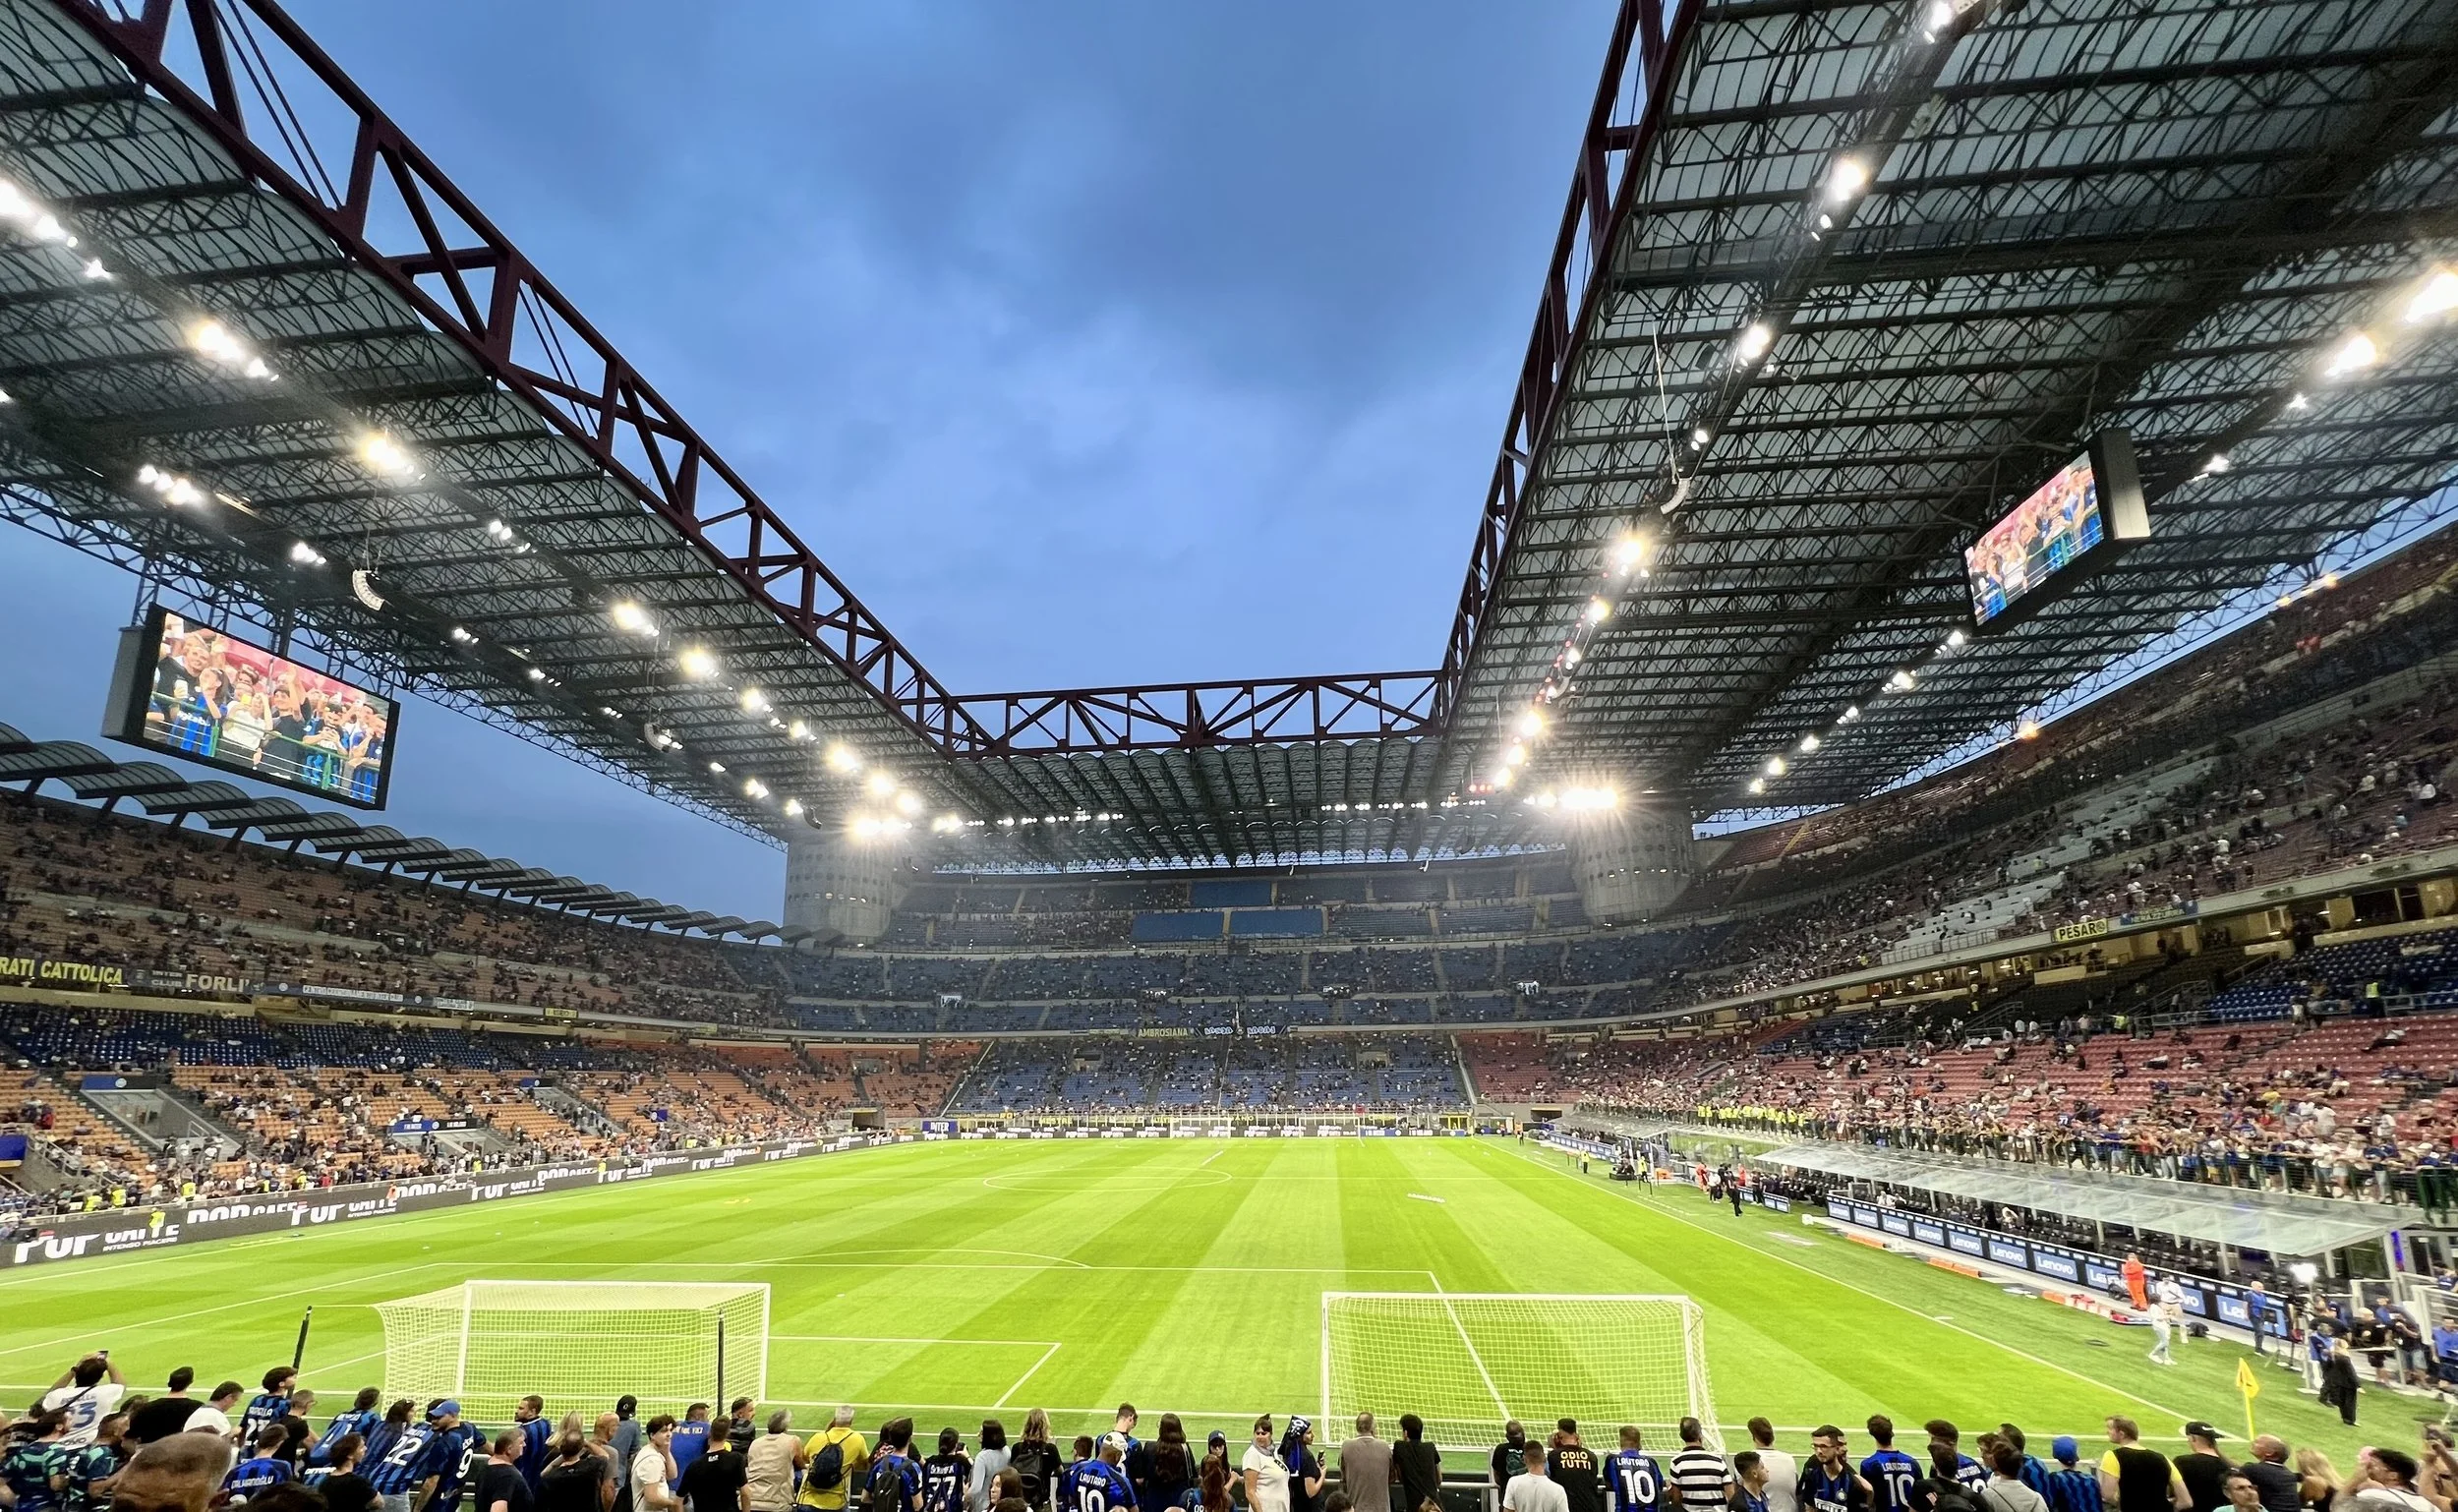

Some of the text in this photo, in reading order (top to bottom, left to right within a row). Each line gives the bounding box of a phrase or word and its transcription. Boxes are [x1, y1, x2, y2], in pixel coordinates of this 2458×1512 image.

[40, 960, 123, 984] CATTOLICA
[1138, 1027, 1189, 1037] AMBROSIANA
[1885, 1217, 1906, 1231] Lenovo
[1917, 1226, 1941, 1241] Lenovo
[1952, 1237, 1980, 1251] Lenovo
[1992, 1246, 2023, 1262] Lenovo
[2037, 1256, 2074, 1275] Lenovo
[383, 1436, 423, 1466] 22
[1560, 1451, 1588, 1460] ODIO
[456, 1448, 473, 1479] 9
[1560, 1459, 1591, 1470] TUTTI
[1616, 1457, 1650, 1467] LAUTARO
[1882, 1462, 1911, 1472] LAUTARO
[1079, 1473, 1106, 1487] LAUTARO
[1619, 1469, 1656, 1504] 10
[1883, 1474, 1915, 1507] 10
[1077, 1485, 1105, 1512] 10
